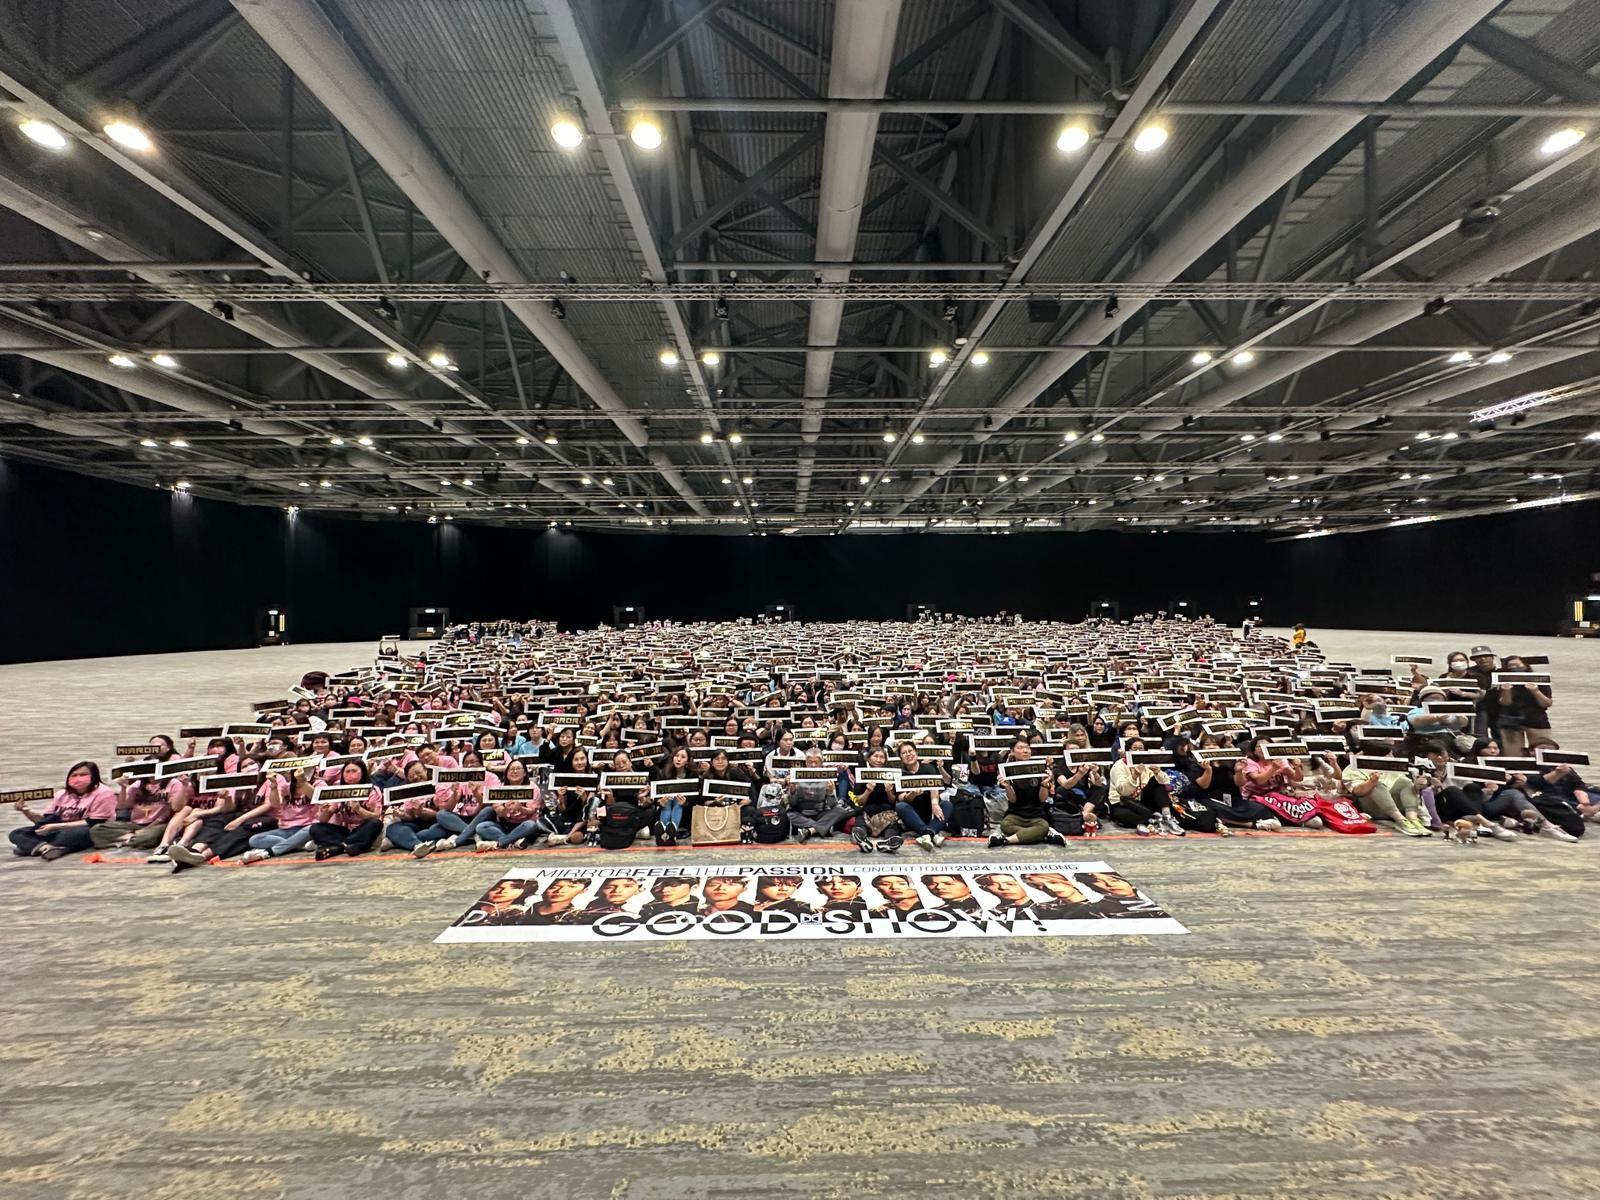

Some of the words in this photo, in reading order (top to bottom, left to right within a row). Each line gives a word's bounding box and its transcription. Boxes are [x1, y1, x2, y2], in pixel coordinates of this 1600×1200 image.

[117, 747, 159, 755] MIRROR
[796, 771, 837, 779] MIRROR
[606, 776, 647, 785] MIRROR
[901, 778, 943, 788] MIRROR
[0, 789, 53, 802] MIRROR
[320, 788, 369, 800] MIRROR
[490, 789, 533, 799] MIRROR
[536, 868, 633, 878] MIRROR
[632, 867, 689, 877] FEEL
[695, 866, 736, 876] THE
[738, 865, 844, 876] PASSION
[592, 911, 800, 937] GOOD
[825, 908, 1048, 935] SHOW!
